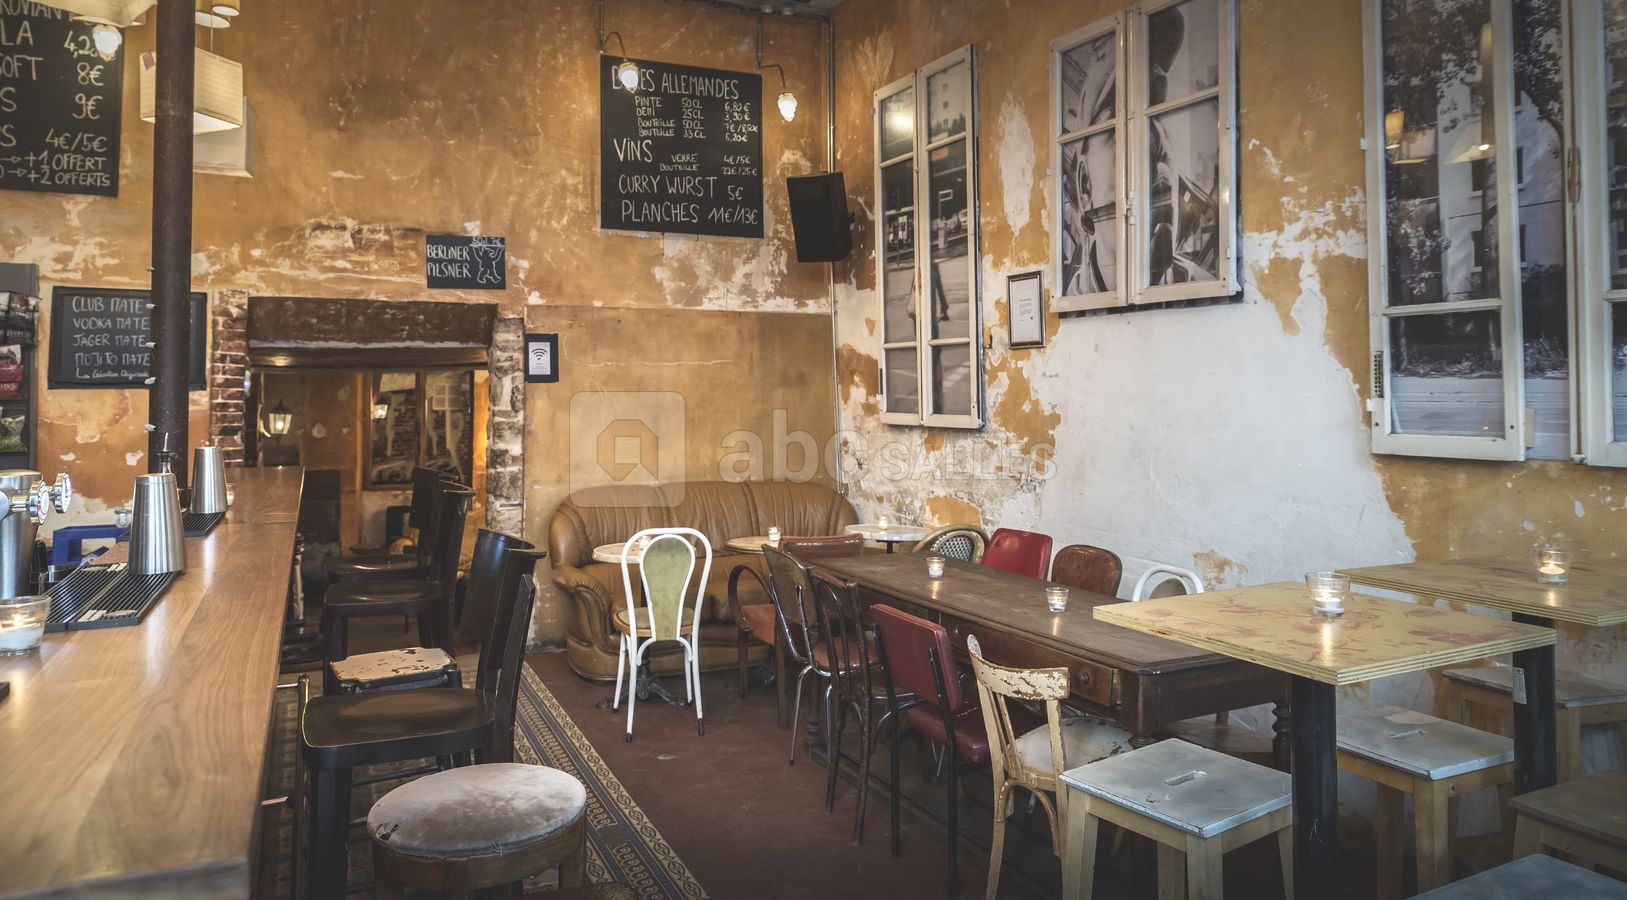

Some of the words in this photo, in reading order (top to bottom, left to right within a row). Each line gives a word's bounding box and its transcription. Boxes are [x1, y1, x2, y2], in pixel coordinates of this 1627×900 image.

[77, 62, 105, 86] 8€
[661, 72, 739, 100] ALLEMANDES
[72, 93, 103, 120] 9€
[635, 96, 662, 108] PINTE
[45, 129, 107, 152] 4€/5€
[614, 137, 653, 163] VINS
[52, 153, 107, 171] OFFERT
[55, 172, 111, 187] OFFERTS
[618, 175, 660, 194] CURRY
[665, 176, 717, 198] WURST
[727, 185, 744, 201] 5€
[622, 199, 700, 223] PLANCHES
[427, 244, 471, 261] BERLINER
[427, 262, 472, 279] PILSNER
[72, 296, 105, 313] CLUB
[110, 298, 145, 314] MATE
[73, 317, 112, 330] VODKA
[116, 317, 150, 330] MATE
[115, 335, 147, 348] MATE
[122, 353, 151, 366] MATE
